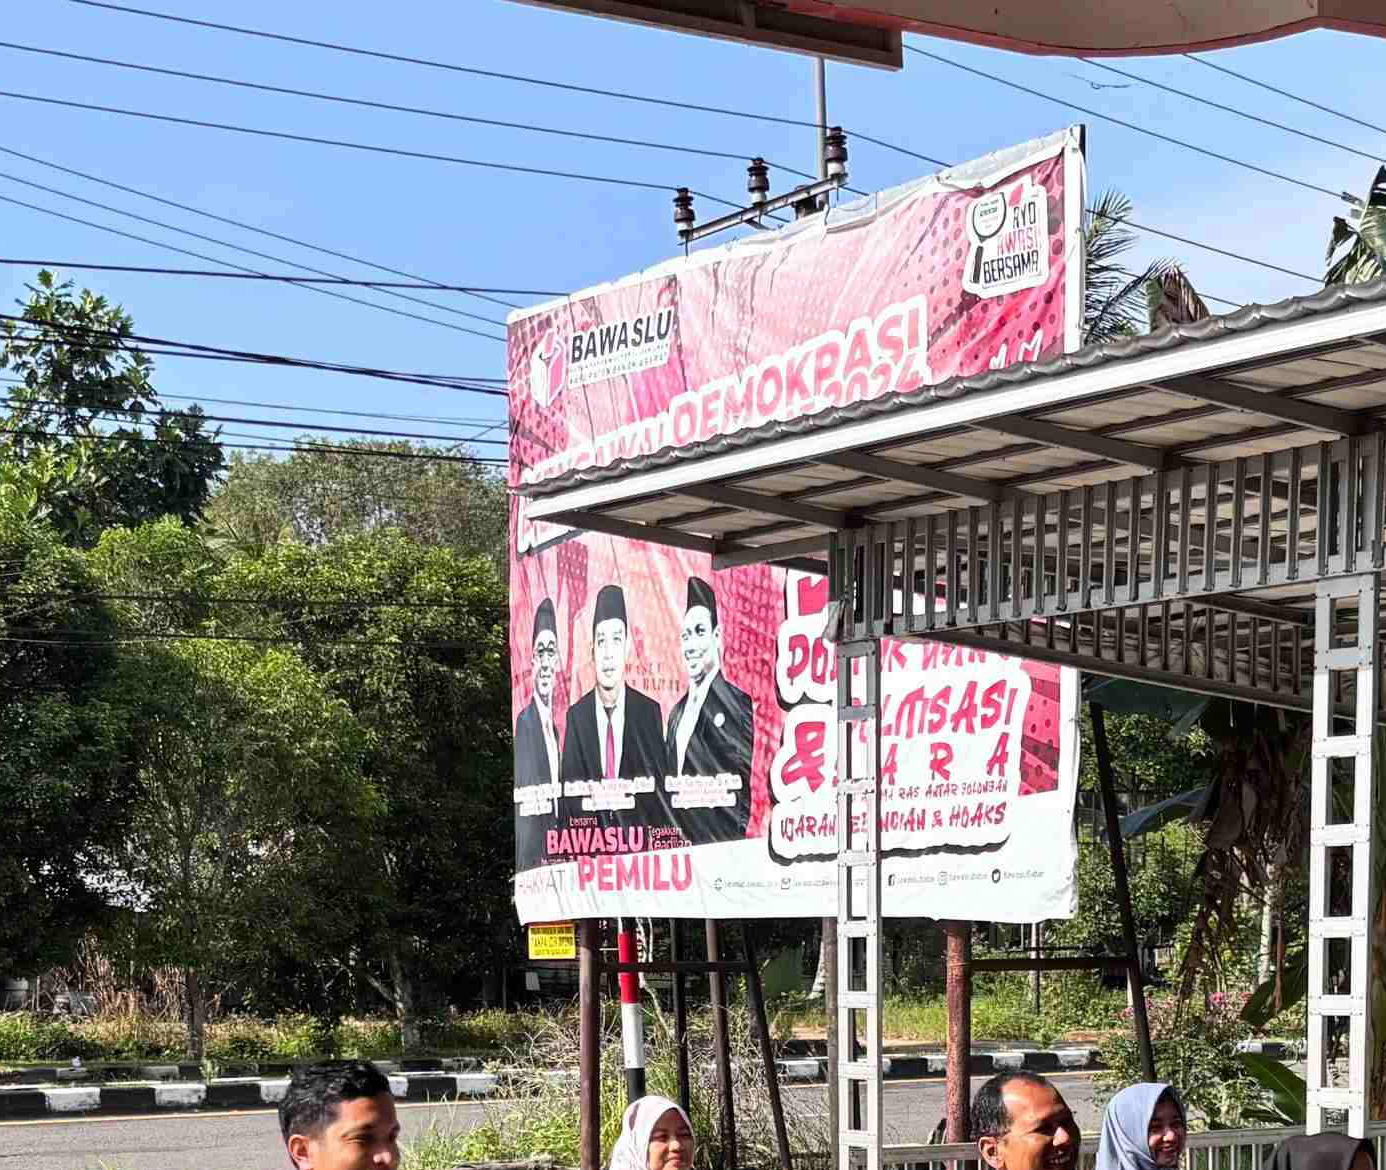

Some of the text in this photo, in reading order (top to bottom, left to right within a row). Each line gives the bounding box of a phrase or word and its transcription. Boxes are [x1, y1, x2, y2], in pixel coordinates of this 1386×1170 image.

[1013, 201, 1036, 229] AYO
[998, 226, 1038, 255] AWASI
[983, 249, 1039, 284] BERSAMA
[571, 309, 672, 364] BAWASLU
[948, 801, 1008, 829] HOAKS
[547, 825, 644, 855] BAWASLU
[577, 853, 694, 892] PEMILU
